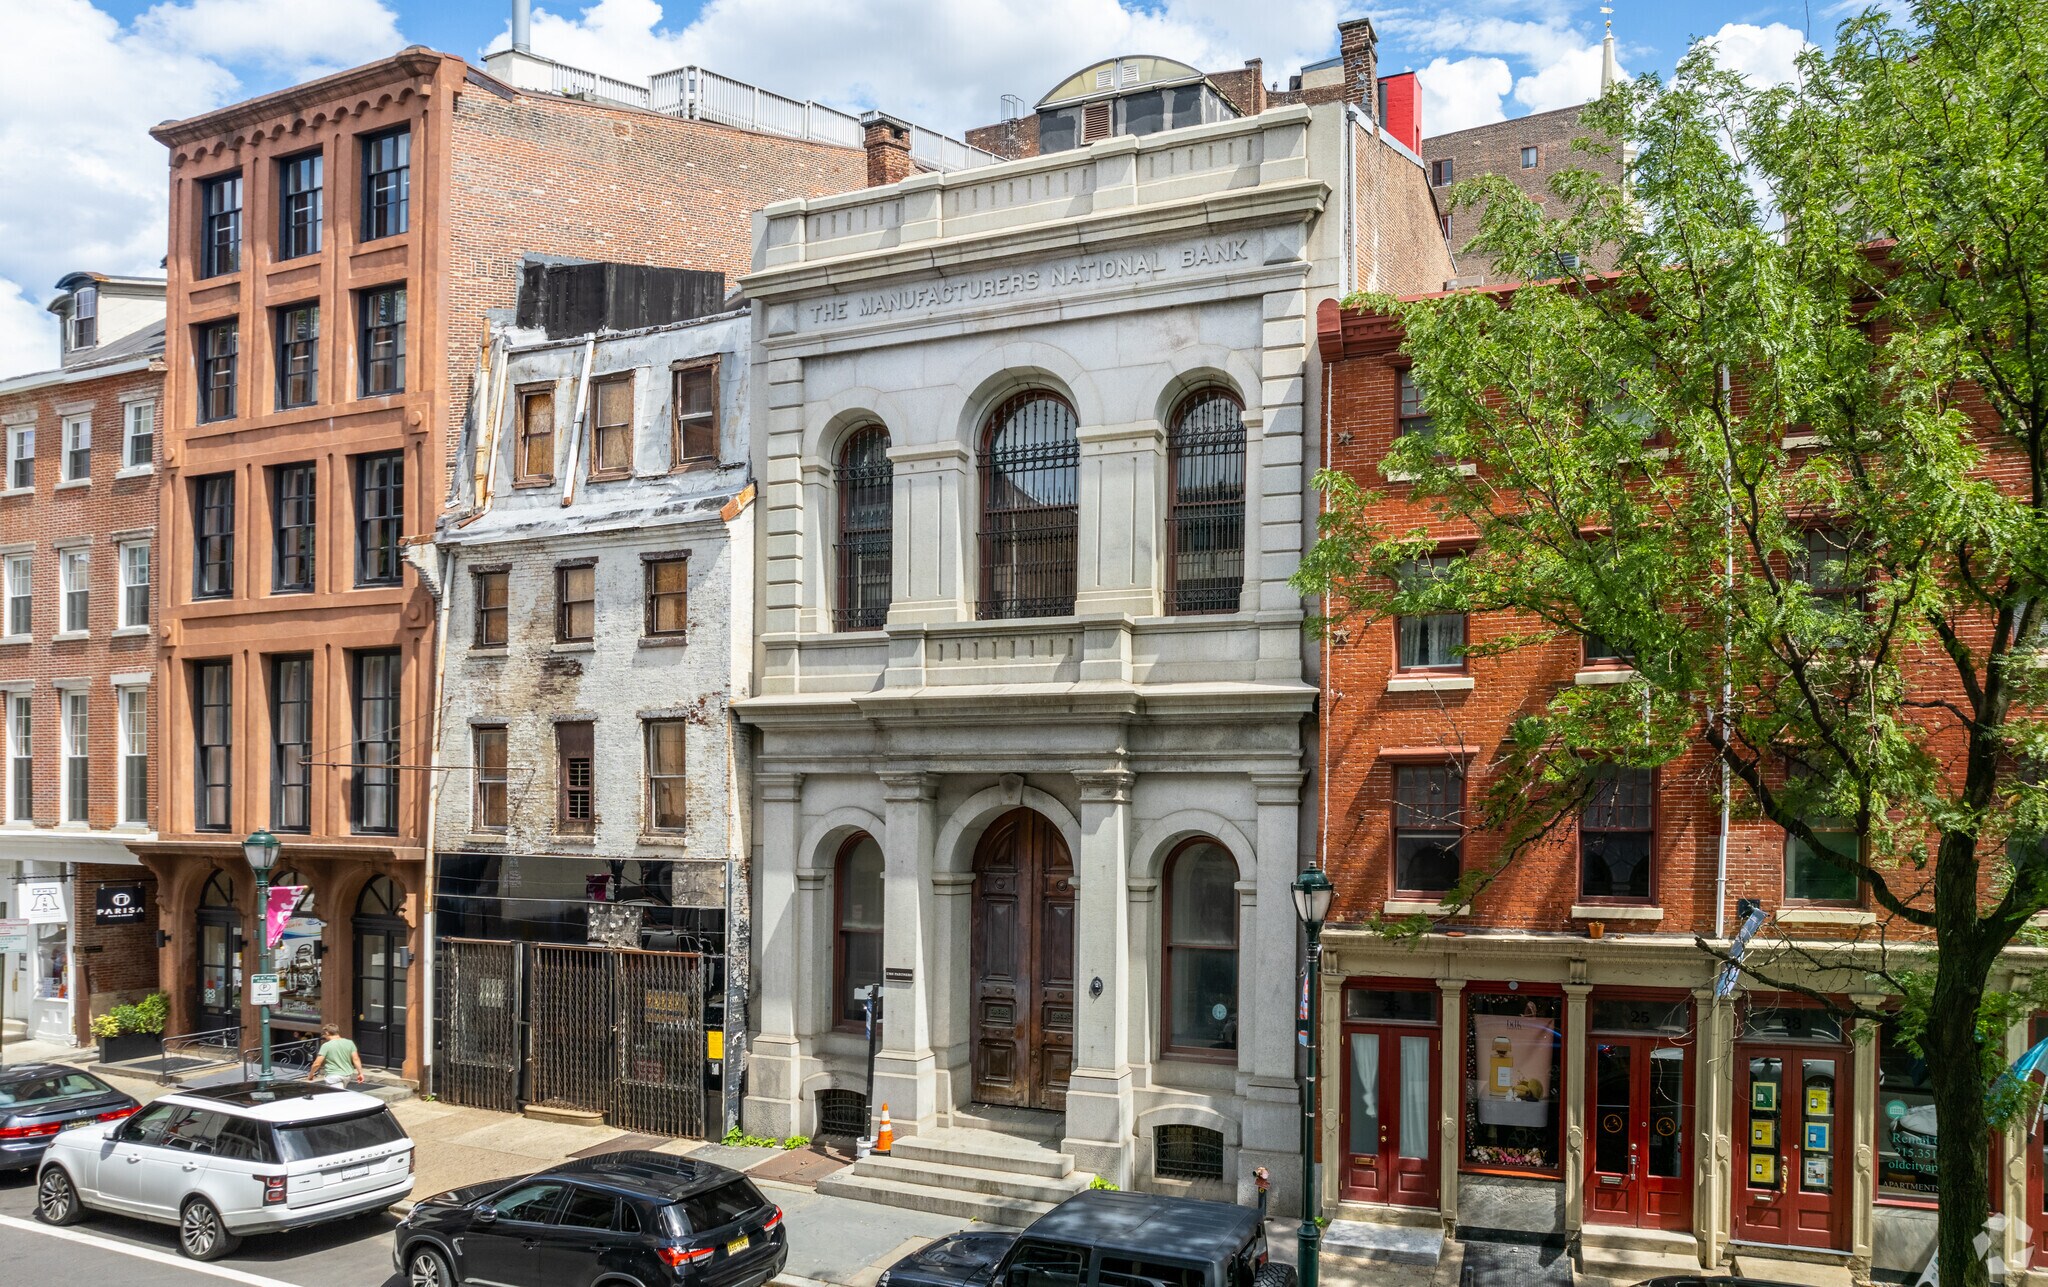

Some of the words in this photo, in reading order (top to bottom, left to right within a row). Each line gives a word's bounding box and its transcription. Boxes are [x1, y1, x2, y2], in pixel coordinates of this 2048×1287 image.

[810, 301, 848, 324] THE
[859, 271, 1039, 316] MANUFACTURERS
[1051, 252, 1166, 287] NATIONAL
[1181, 239, 1248, 269] BANK
[96, 906, 144, 916] PARISA
[1630, 1010, 1650, 1023] 25
[318, 1158, 354, 1168] RANGE
[360, 1149, 392, 1159] ROVER
